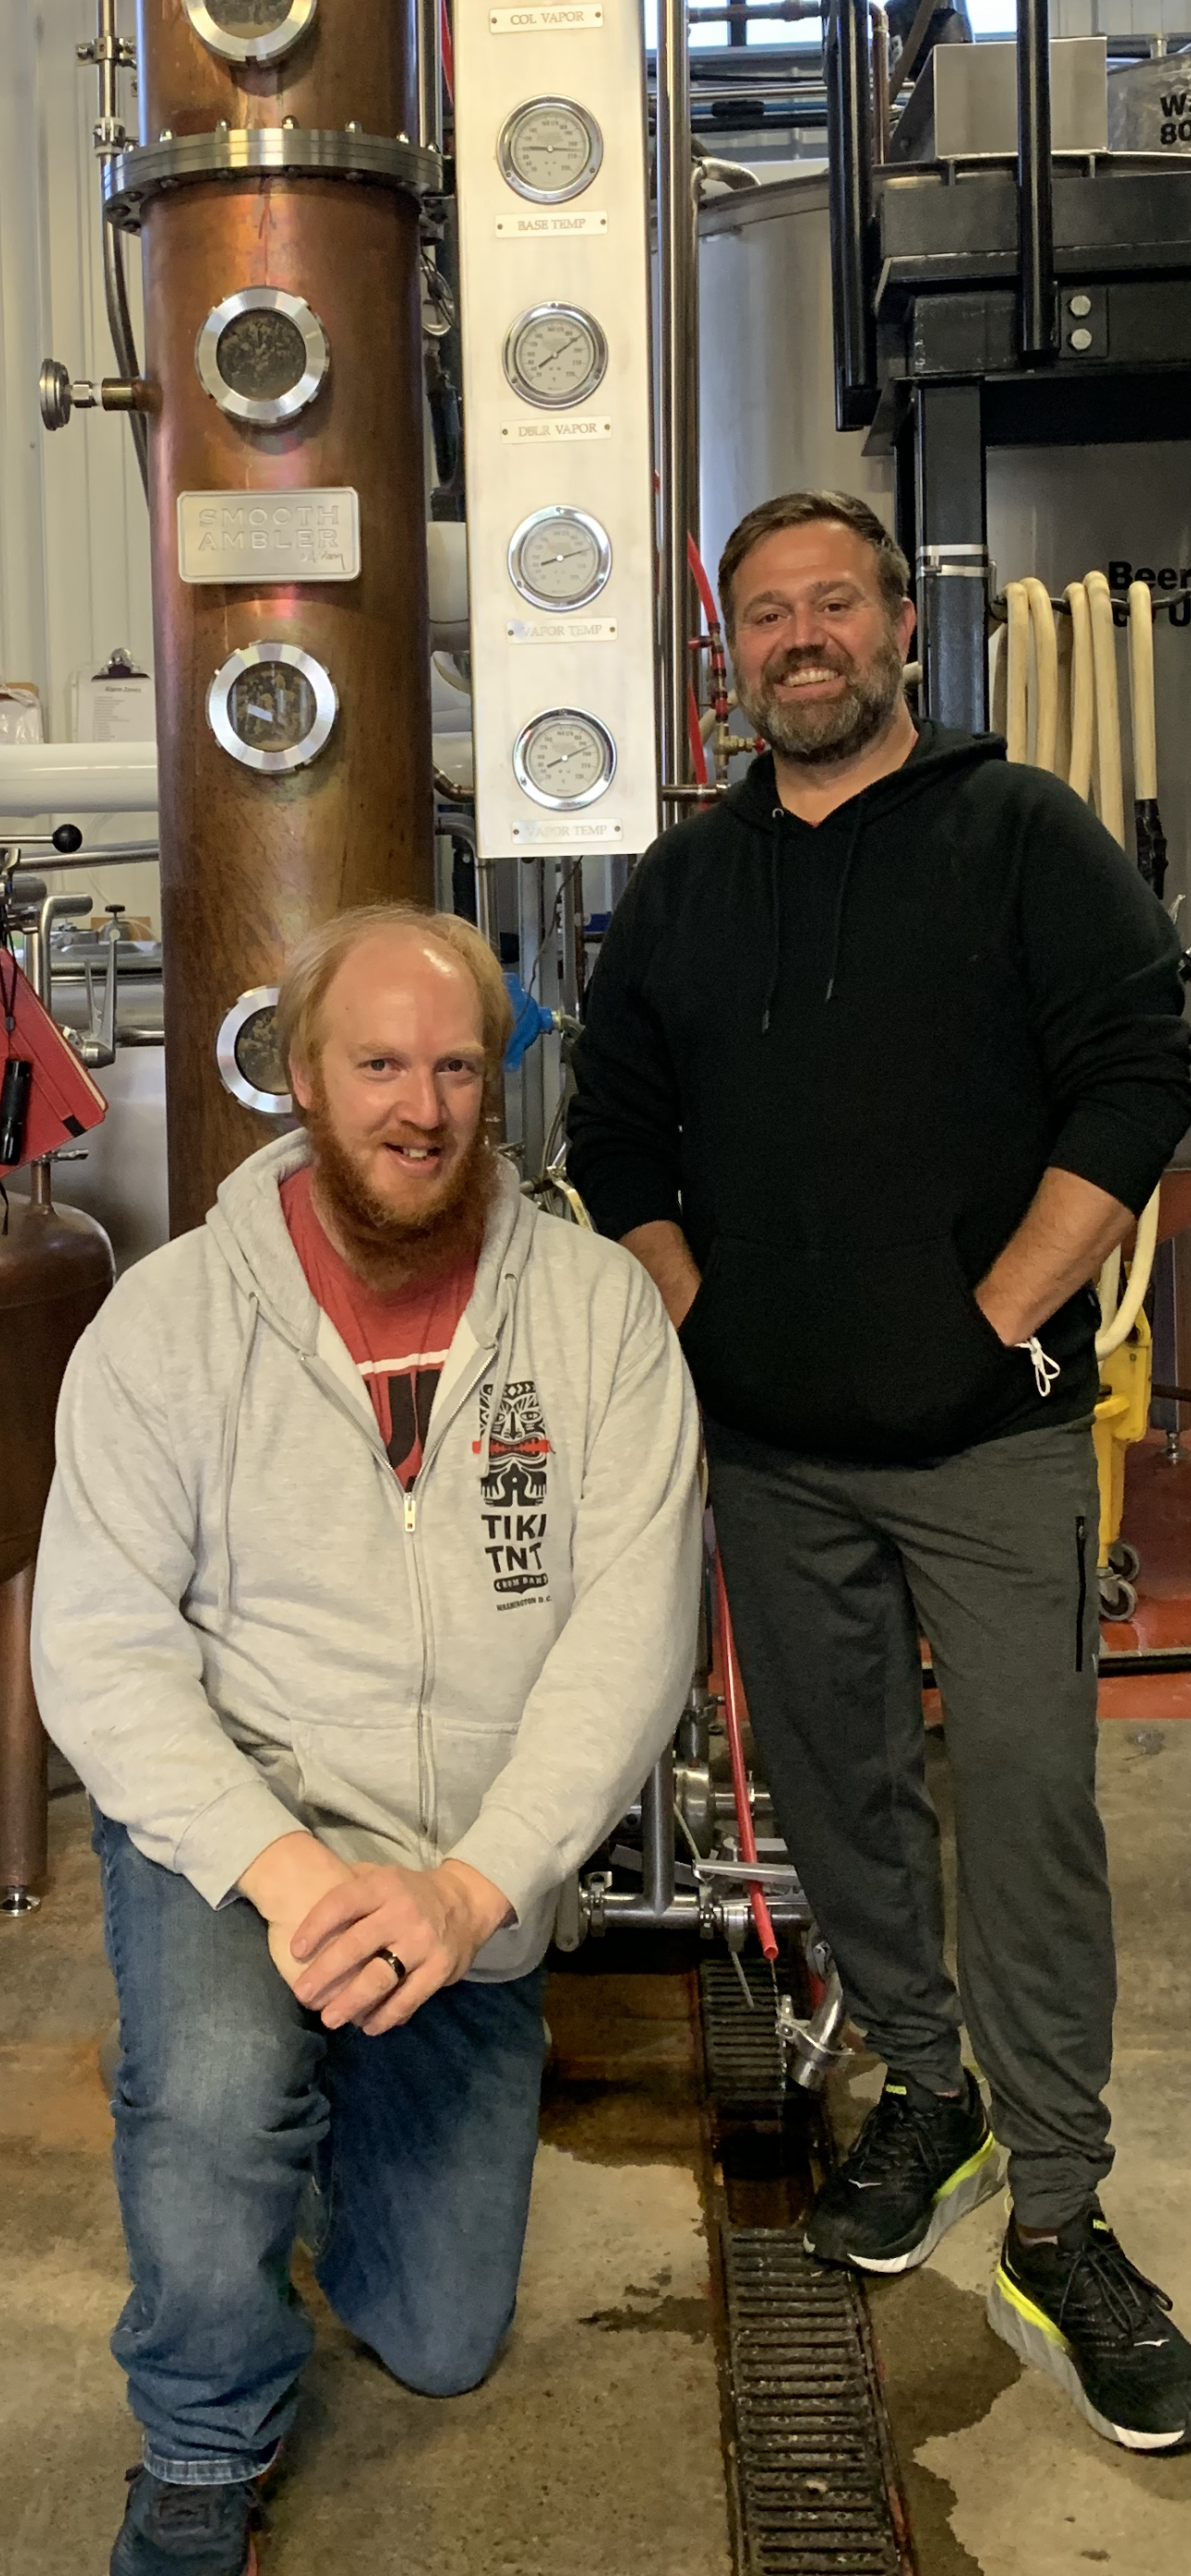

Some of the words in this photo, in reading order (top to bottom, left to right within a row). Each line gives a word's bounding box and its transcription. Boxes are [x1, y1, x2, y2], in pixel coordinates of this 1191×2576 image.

[509, 13, 537, 25] COL
[540, 10, 584, 24] VAPOR
[517, 219, 549, 231] BASE
[550, 218, 586, 230] TEMP
[555, 423, 598, 436] VAPOR
[198, 504, 340, 528] SMOOTH
[198, 529, 339, 551] AMBLER
[522, 625, 566, 637] VAPOR
[567, 624, 603, 636] TEMP
[525, 825, 570, 837] VAPOR
[572, 824, 608, 836] TEMP
[480, 1513, 547, 1541] TIKI
[484, 1541, 543, 1574] TNT
[496, 1597, 537, 1612] WASHINGTON
